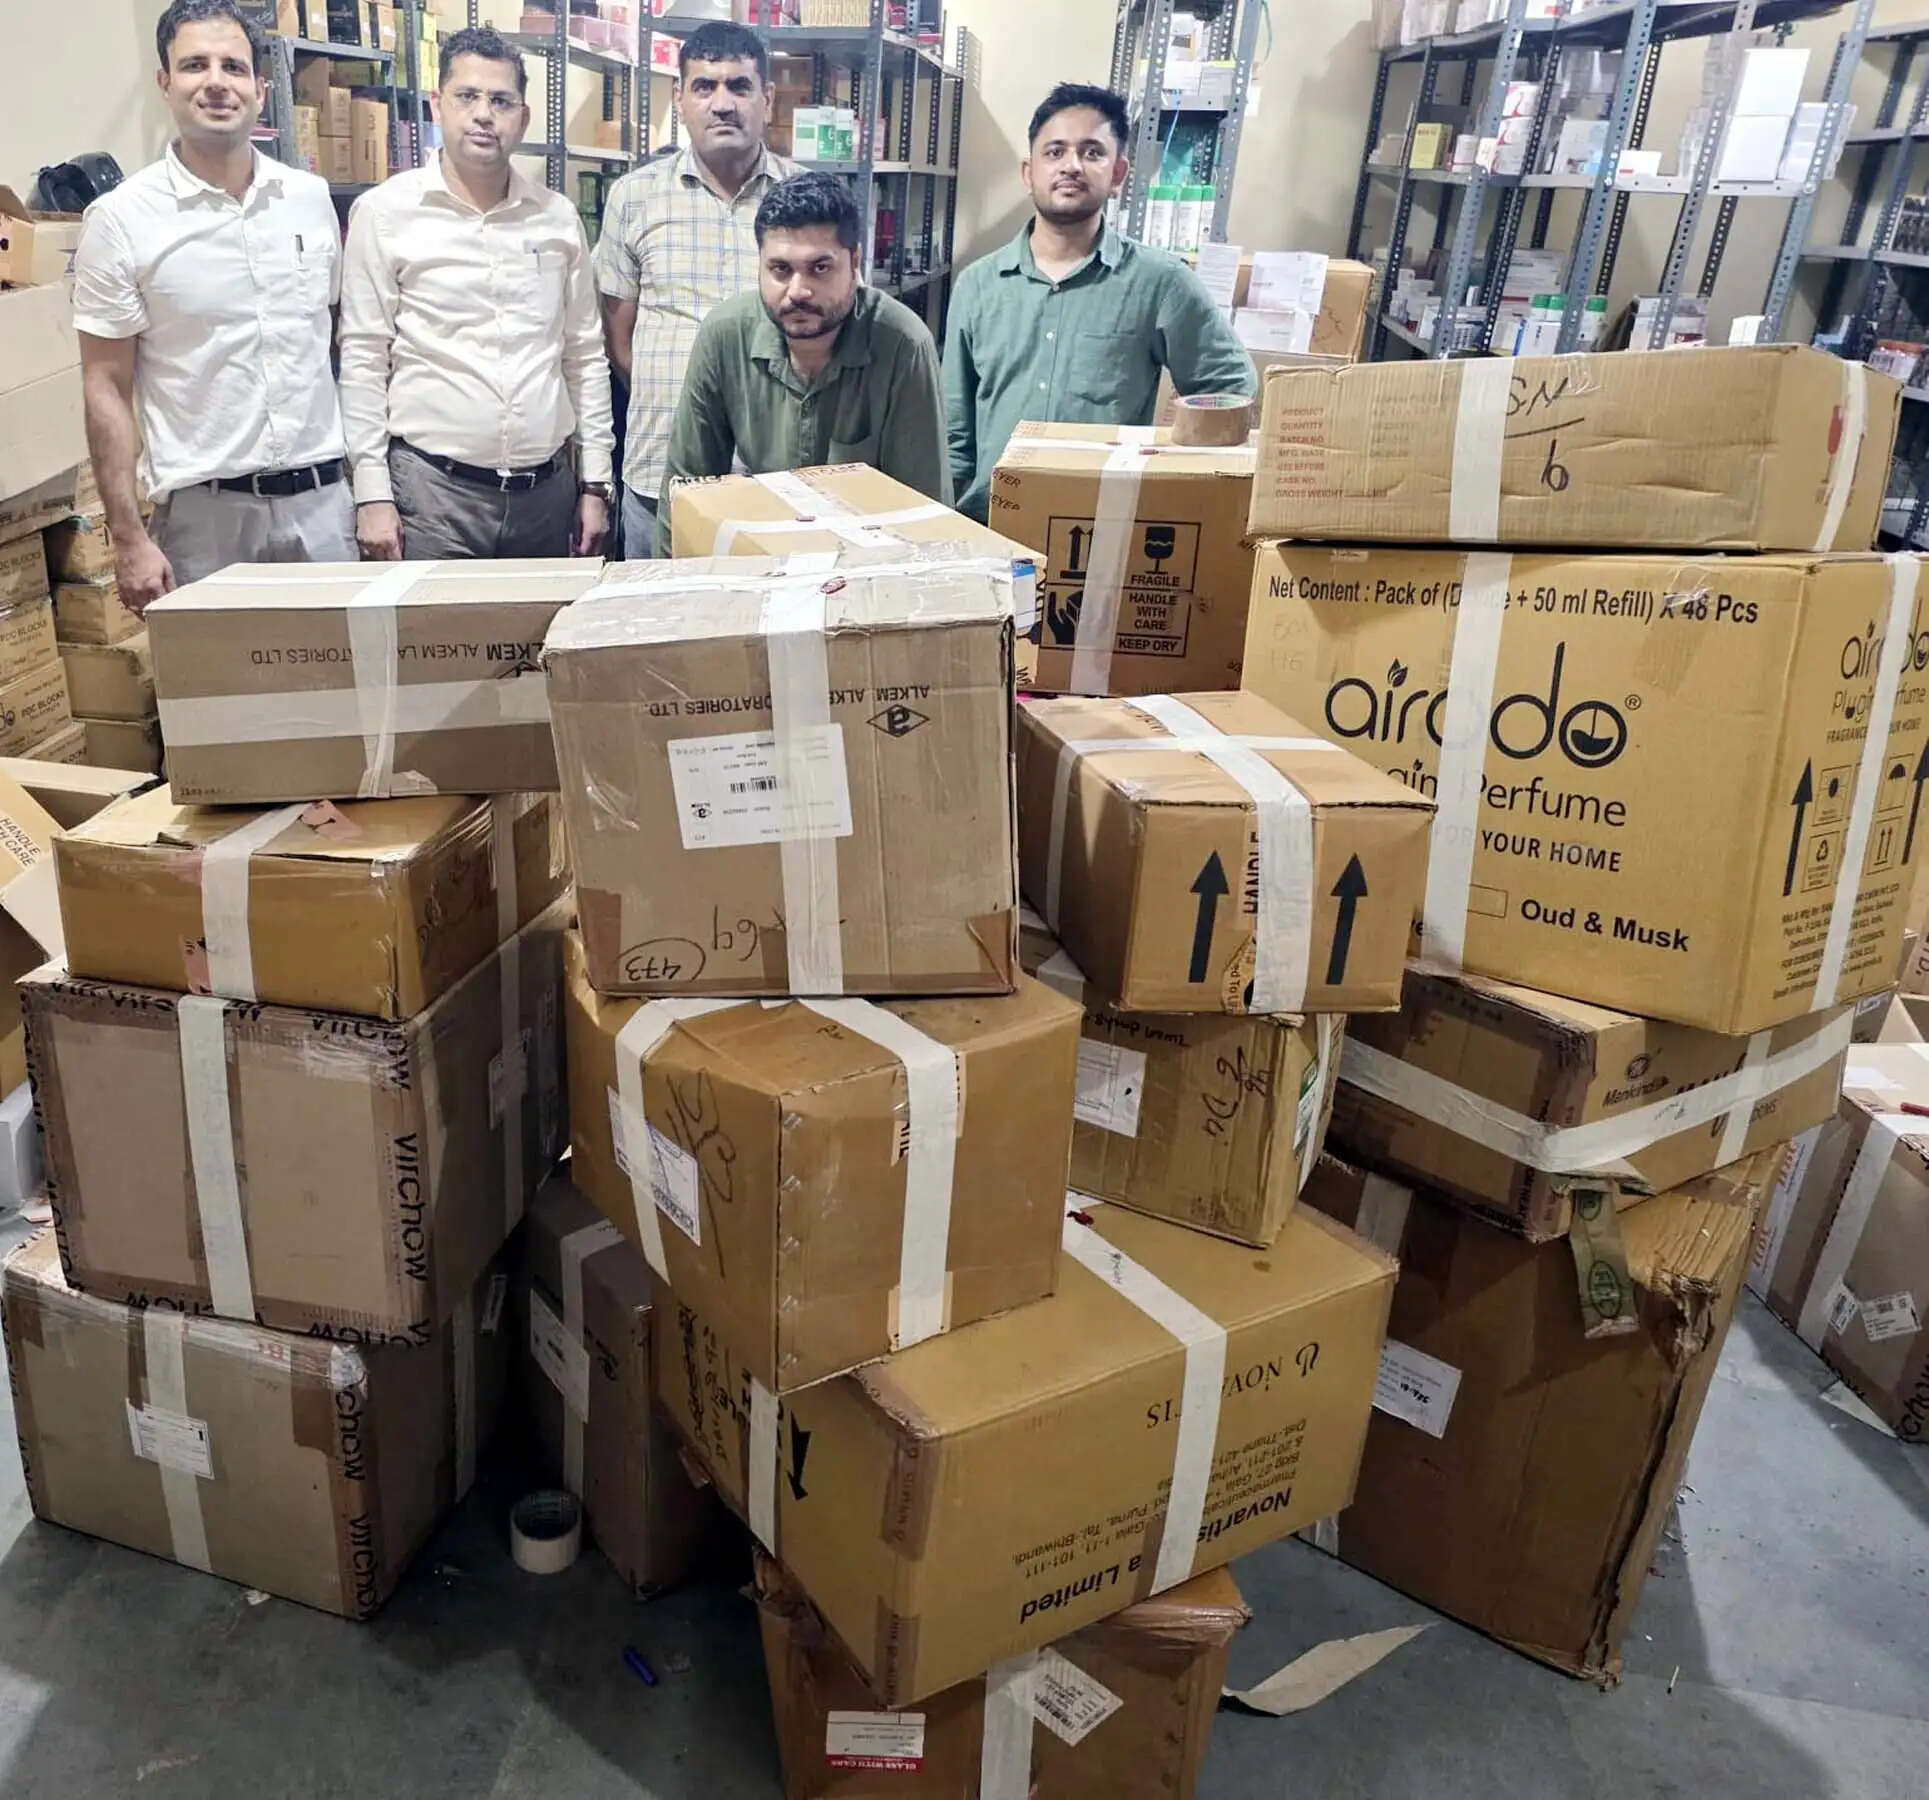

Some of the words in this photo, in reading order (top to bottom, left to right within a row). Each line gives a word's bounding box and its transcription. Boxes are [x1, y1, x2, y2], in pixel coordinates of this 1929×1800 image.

[1130, 574, 1181, 588] FRAGILE
[1129, 592, 1178, 606] HANDLE
[1269, 575, 1295, 599] Net
[1298, 576, 1360, 603] Content
[1374, 579, 1416, 606] Pack
[1420, 582, 1440, 606] of
[1533, 587, 1557, 613] 50
[1562, 588, 1588, 615] ml
[1592, 588, 1655, 625] Refill)
[1715, 594, 1760, 624] Pcs
[1136, 606, 1167, 618] WITH
[1134, 618, 1167, 631] CARE
[423, 640, 479, 659] ALKEM
[487, 641, 544, 661] LKEM
[1118, 637, 1150, 650] KEEP
[1152, 639, 1178, 652] DRY
[251, 649, 282, 665] LTD
[828, 687, 865, 706] ALKE
[876, 684, 930, 701] ALKEM
[647, 701, 679, 716] LTD.
[1, 817, 41, 856] HANDLE
[5, 838, 36, 867] CARE
[1481, 829, 1541, 859] YOUR
[1550, 841, 1622, 873] HOME
[1521, 898, 1576, 929] Oud
[1584, 911, 1603, 935] &
[1612, 916, 1690, 952] Musk
[1196, 1486, 1293, 1543] Novartis
[1019, 1563, 1121, 1625] Limited
